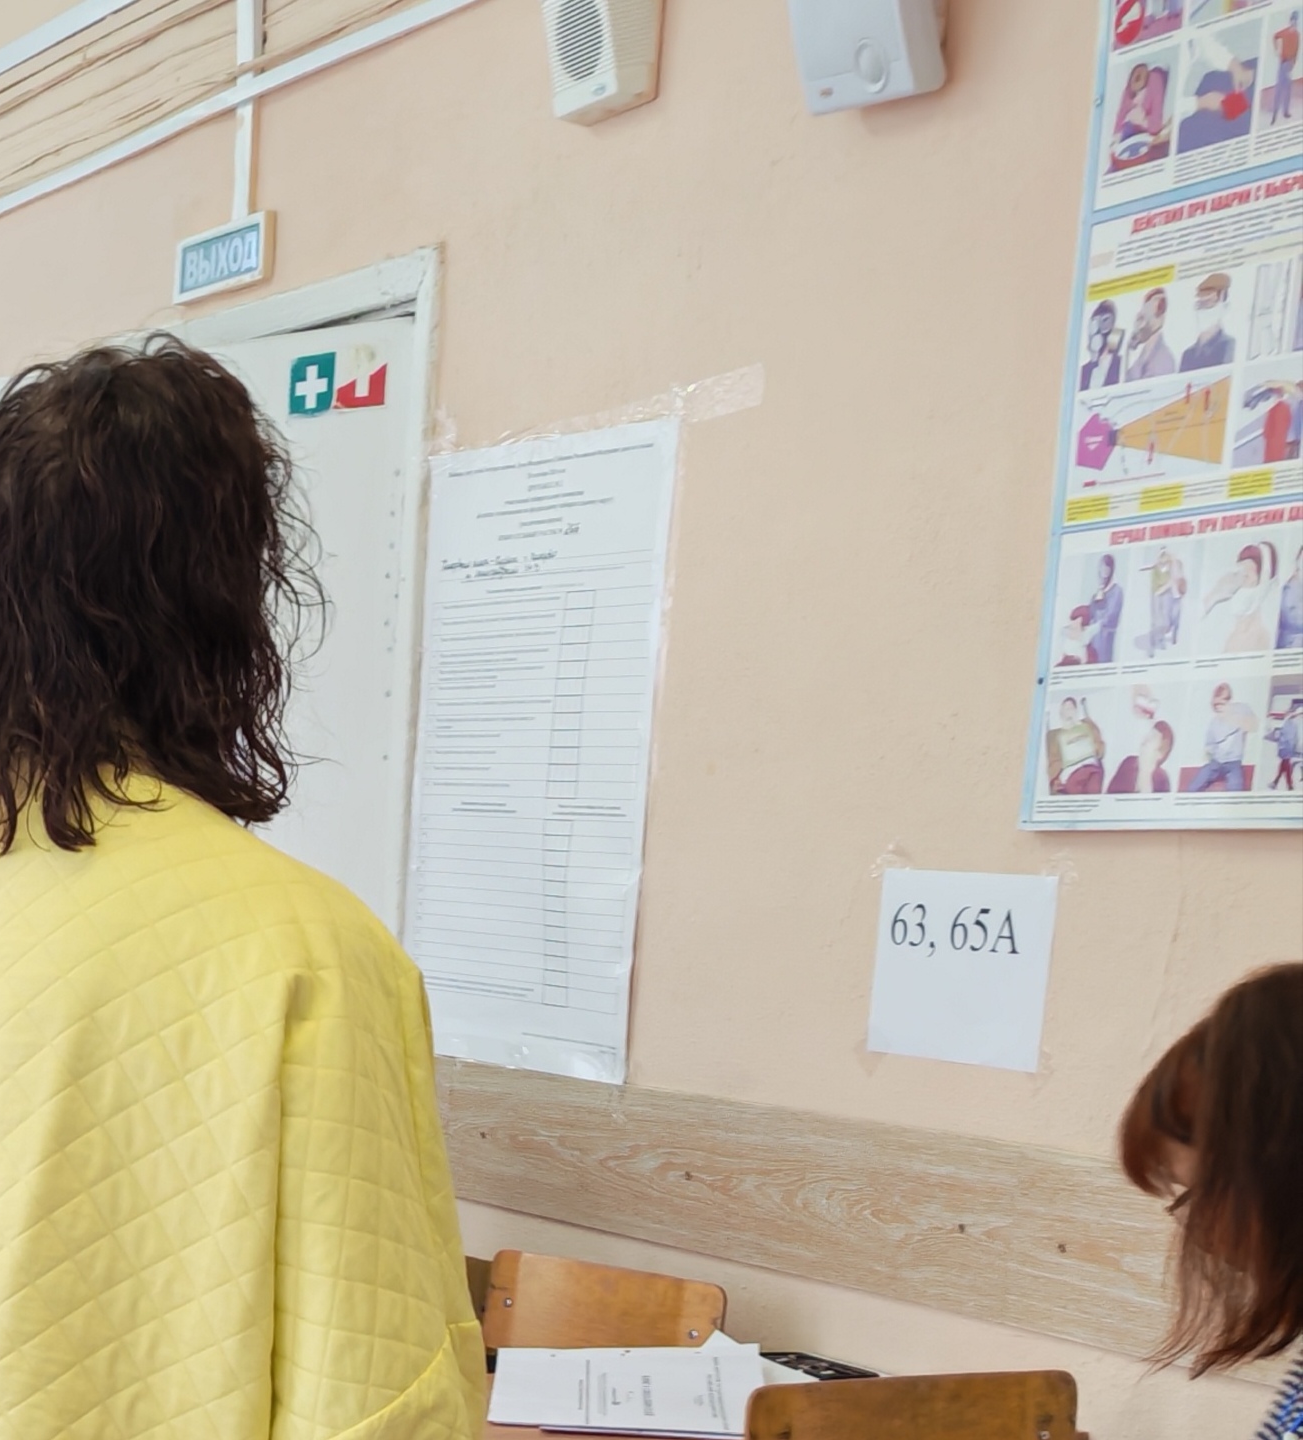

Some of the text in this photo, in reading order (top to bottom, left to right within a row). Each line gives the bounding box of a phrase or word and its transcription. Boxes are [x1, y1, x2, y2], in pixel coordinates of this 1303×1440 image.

[185, 231, 258, 285] ВЫХОД
[891, 902, 1020, 958] 63, 65А
